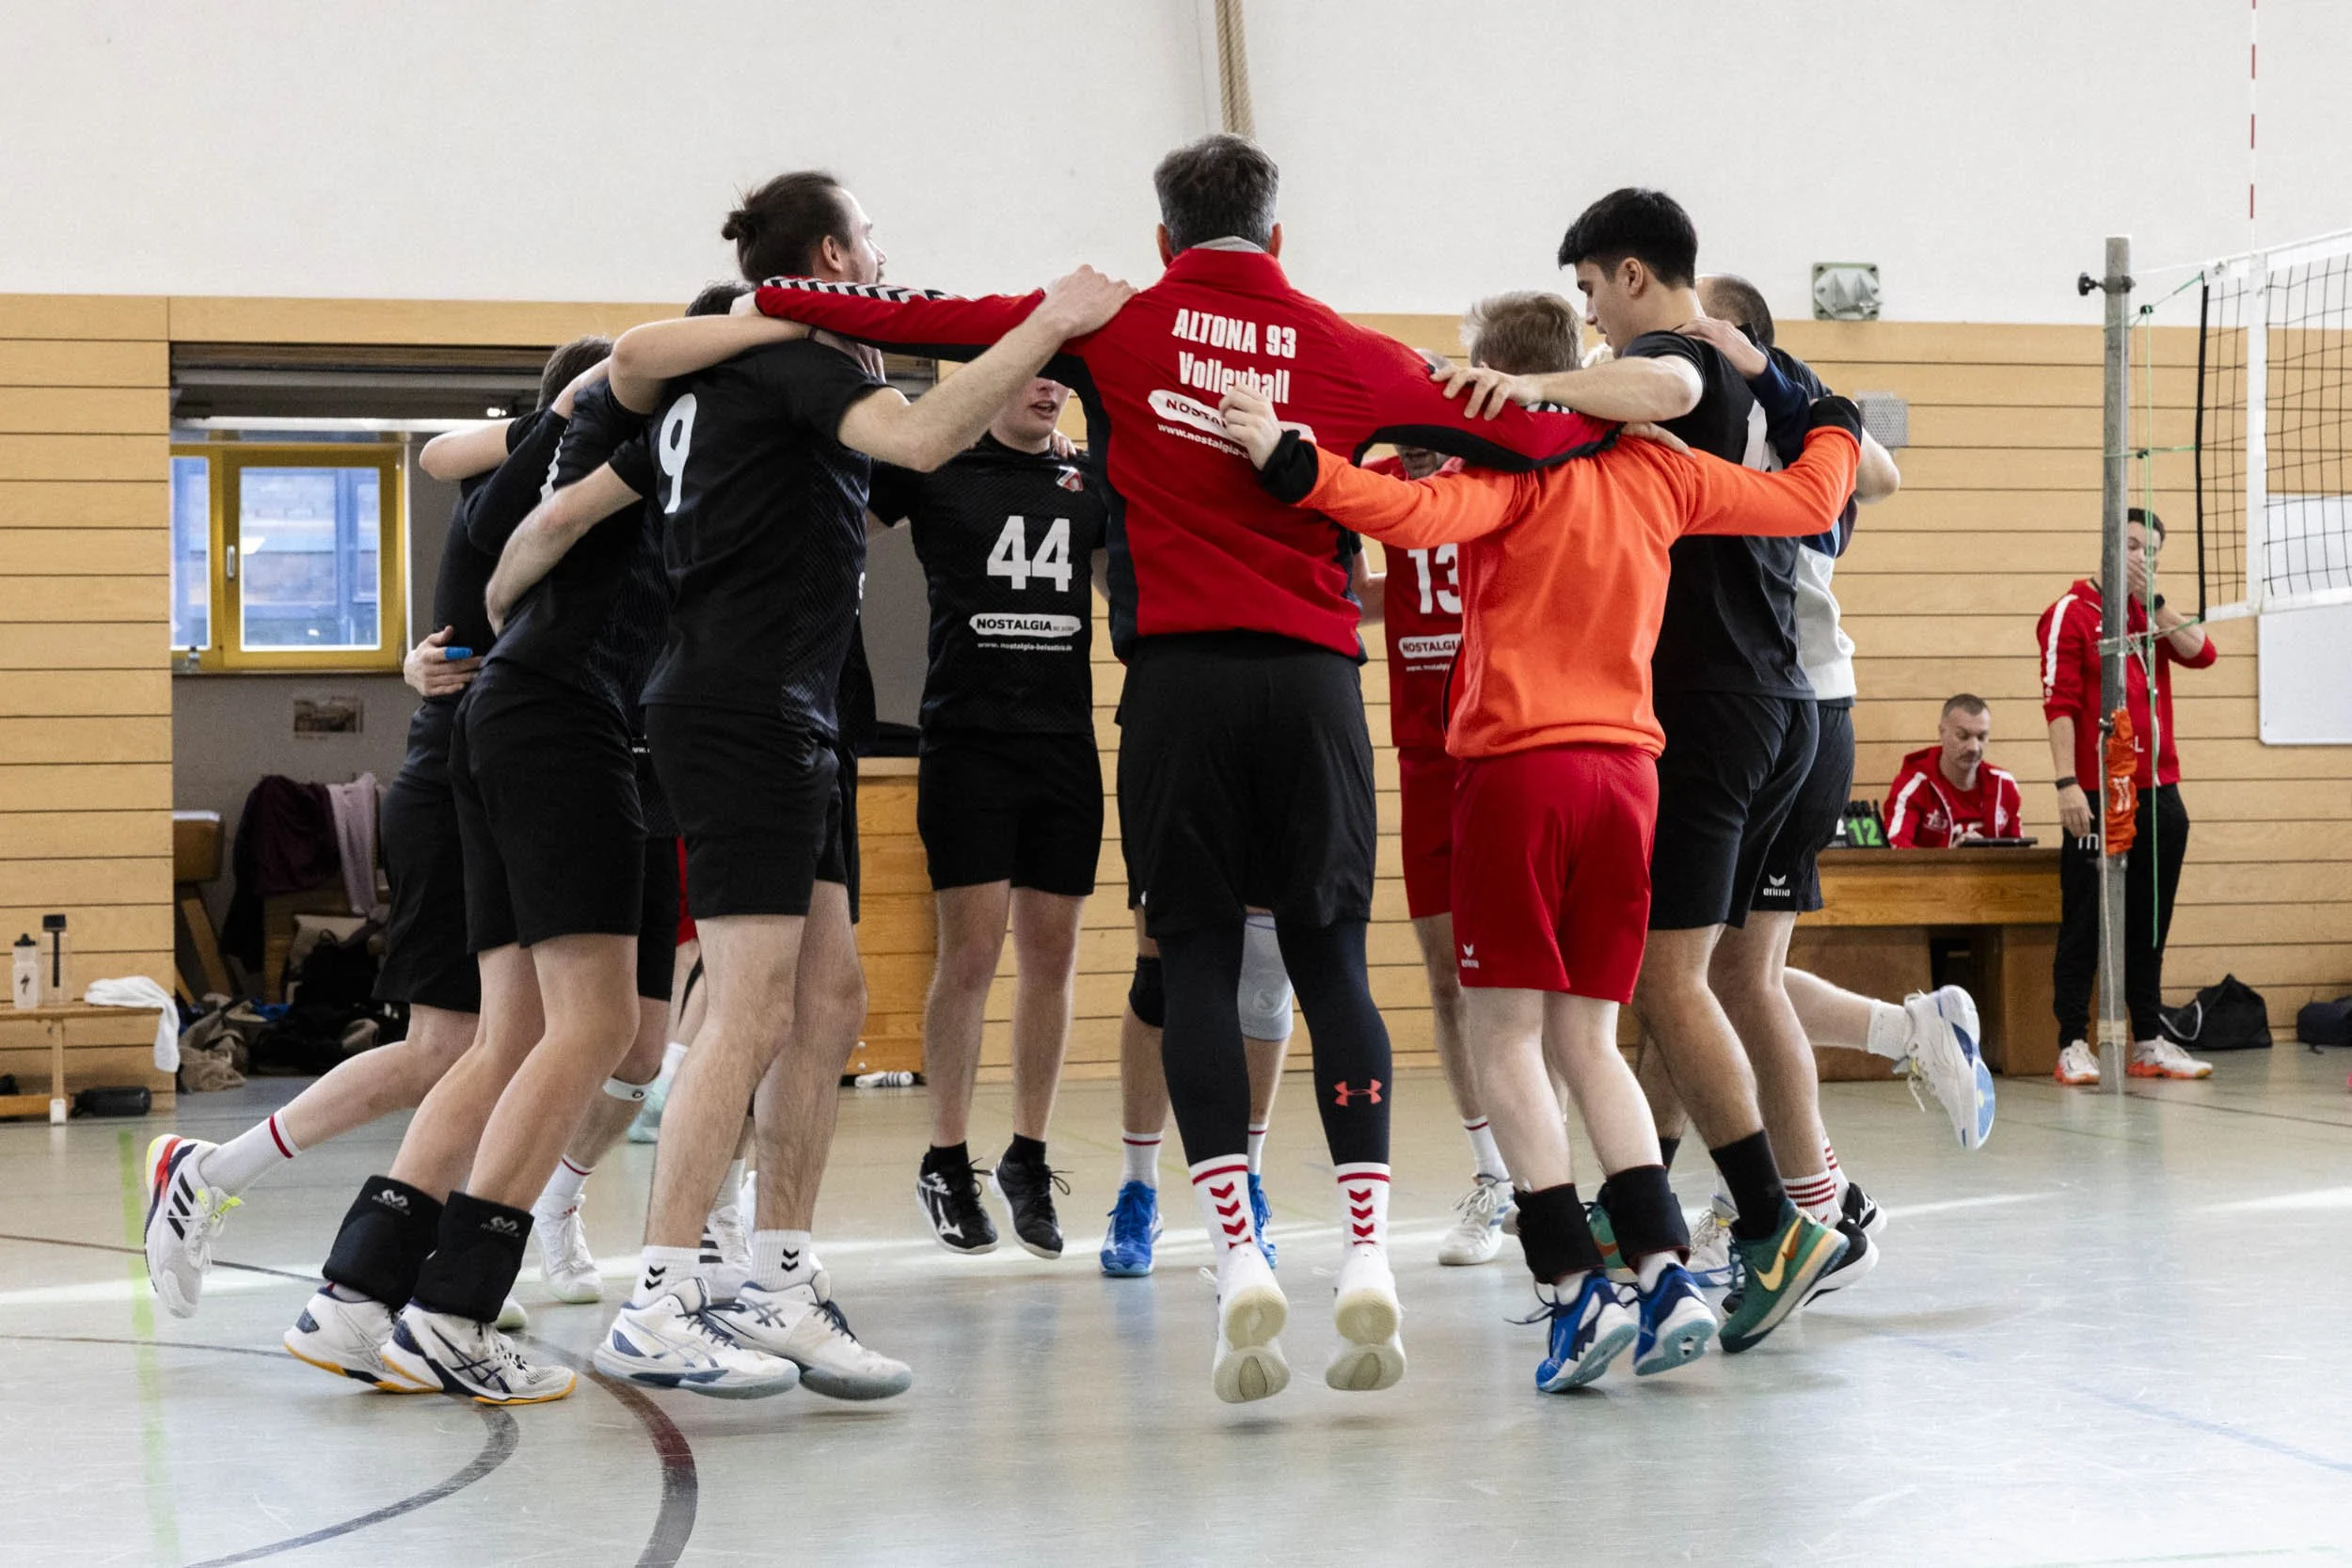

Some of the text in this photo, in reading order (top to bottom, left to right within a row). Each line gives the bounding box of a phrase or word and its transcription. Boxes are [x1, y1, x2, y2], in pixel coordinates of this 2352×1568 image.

[1171, 308, 1296, 358] ALTONA 93
[660, 392, 697, 514] 9
[986, 515, 1073, 593] 44
[1406, 543, 1463, 614] 13
[977, 618, 1053, 631] NOSTALGIA
[1848, 816, 1883, 846] 12
[1762, 887, 1791, 897] erima
